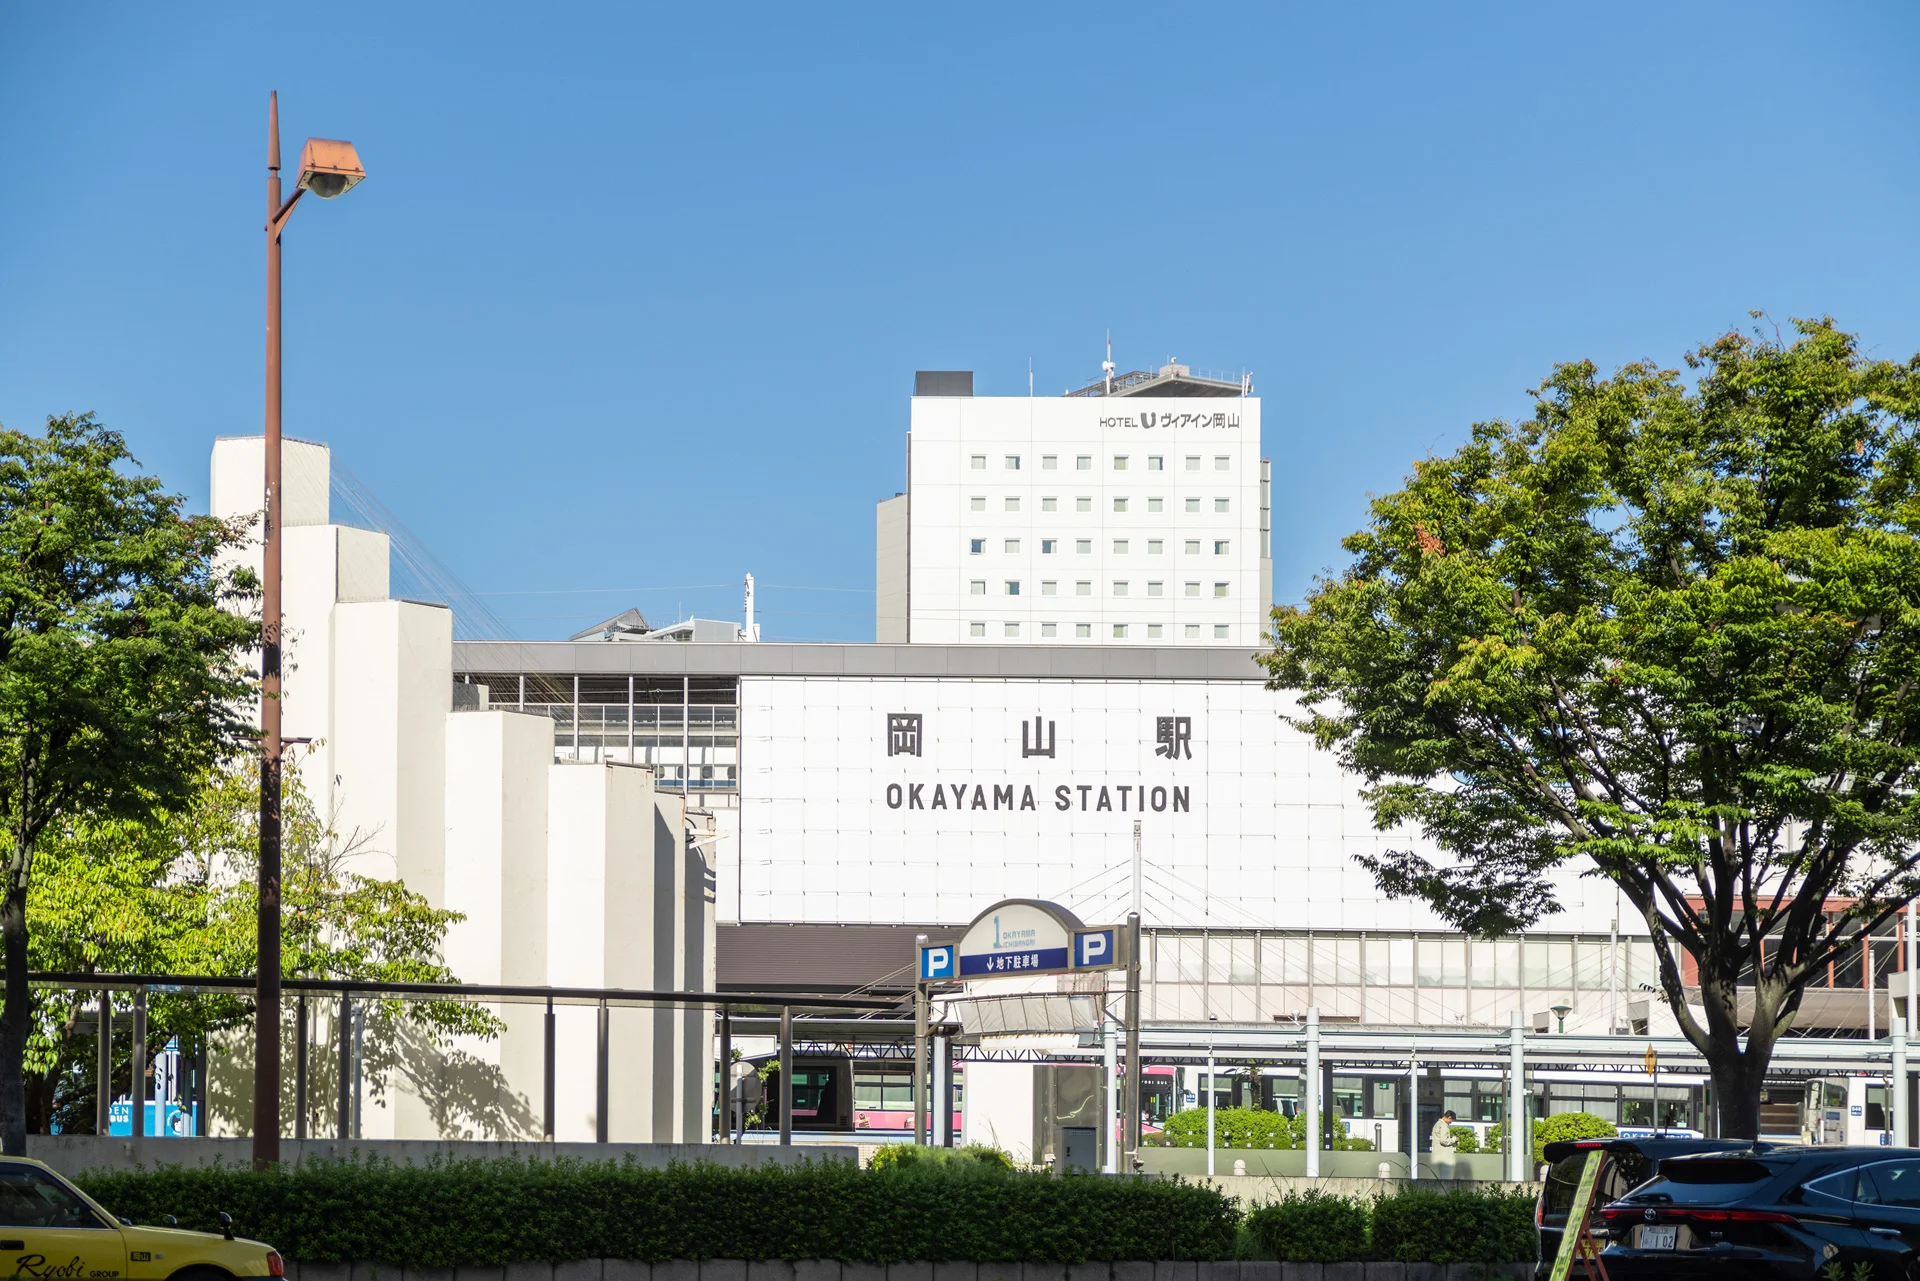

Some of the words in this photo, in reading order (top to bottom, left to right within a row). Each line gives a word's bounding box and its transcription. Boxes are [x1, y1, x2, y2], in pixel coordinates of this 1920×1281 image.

[1099, 417, 1138, 428] HOTEL
[1160, 412, 1240, 428] ヴィアイン岡山
[886, 783, 1036, 811] OKAYAMA
[1055, 785, 1190, 812] STATION
[1003, 929, 1036, 940] OKAYAMA
[928, 948, 949, 977] P
[996, 953, 1039, 970] 地下駐車場
[1082, 933, 1107, 965] P
[16, 1254, 86, 1281] Ryobi
[90, 1270, 120, 1278] GROUP
